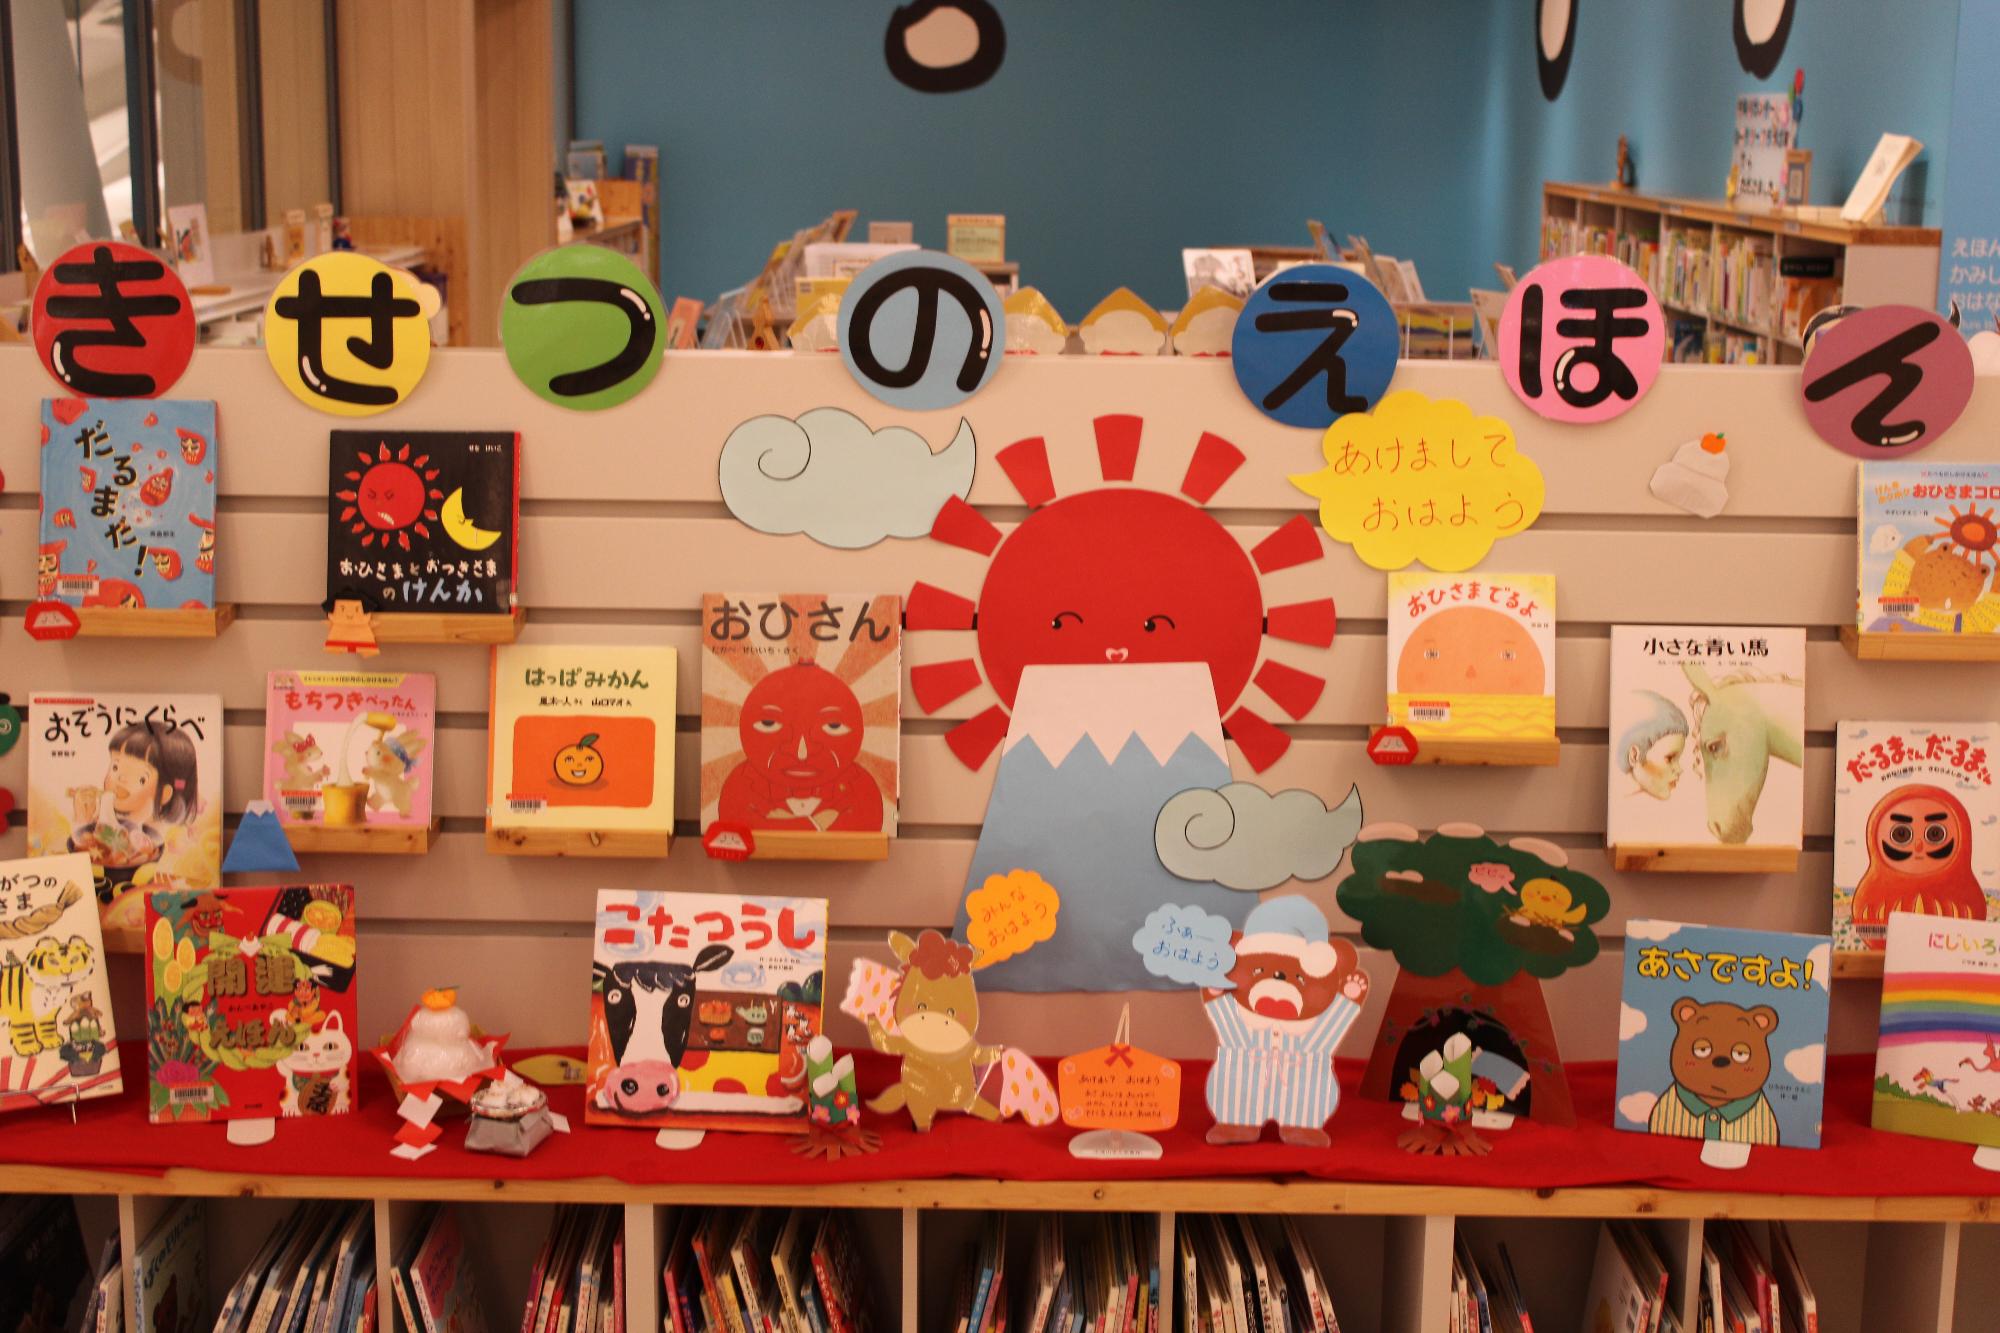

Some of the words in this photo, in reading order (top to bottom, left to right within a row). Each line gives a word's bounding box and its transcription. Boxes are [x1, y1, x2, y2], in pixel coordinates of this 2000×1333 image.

[46, 246, 180, 396] き
[275, 269, 420, 405] せ
[511, 278, 655, 396] つ
[848, 266, 993, 393] の
[1254, 281, 1368, 413] え
[1519, 284, 1649, 407] ほ
[1805, 321, 1941, 447] ん
[1334, 434, 1506, 476] あけまして
[74, 420, 149, 577] だるまだ!
[1363, 492, 1524, 531] おはよう
[340, 558, 497, 581] おひさまとおつきさま
[383, 577, 483, 603] のけんか
[1408, 580, 1539, 619] おひさまでるよ
[710, 600, 890, 642] おひさん
[1643, 637, 1769, 657] 小さな青い馬
[525, 667, 649, 689] はっぱみかん
[285, 691, 416, 711] もちつきぺったん
[45, 703, 205, 743] おぞうにくらべ
[604, 904, 815, 950] こたつうし
[987, 901, 1048, 947] おはよう
[1928, 931, 2000, 955] にじいろ
[1152, 940, 1219, 970] おはよう
[1637, 946, 1814, 990] あさですよ!
[209, 1019, 297, 1049] えほん
